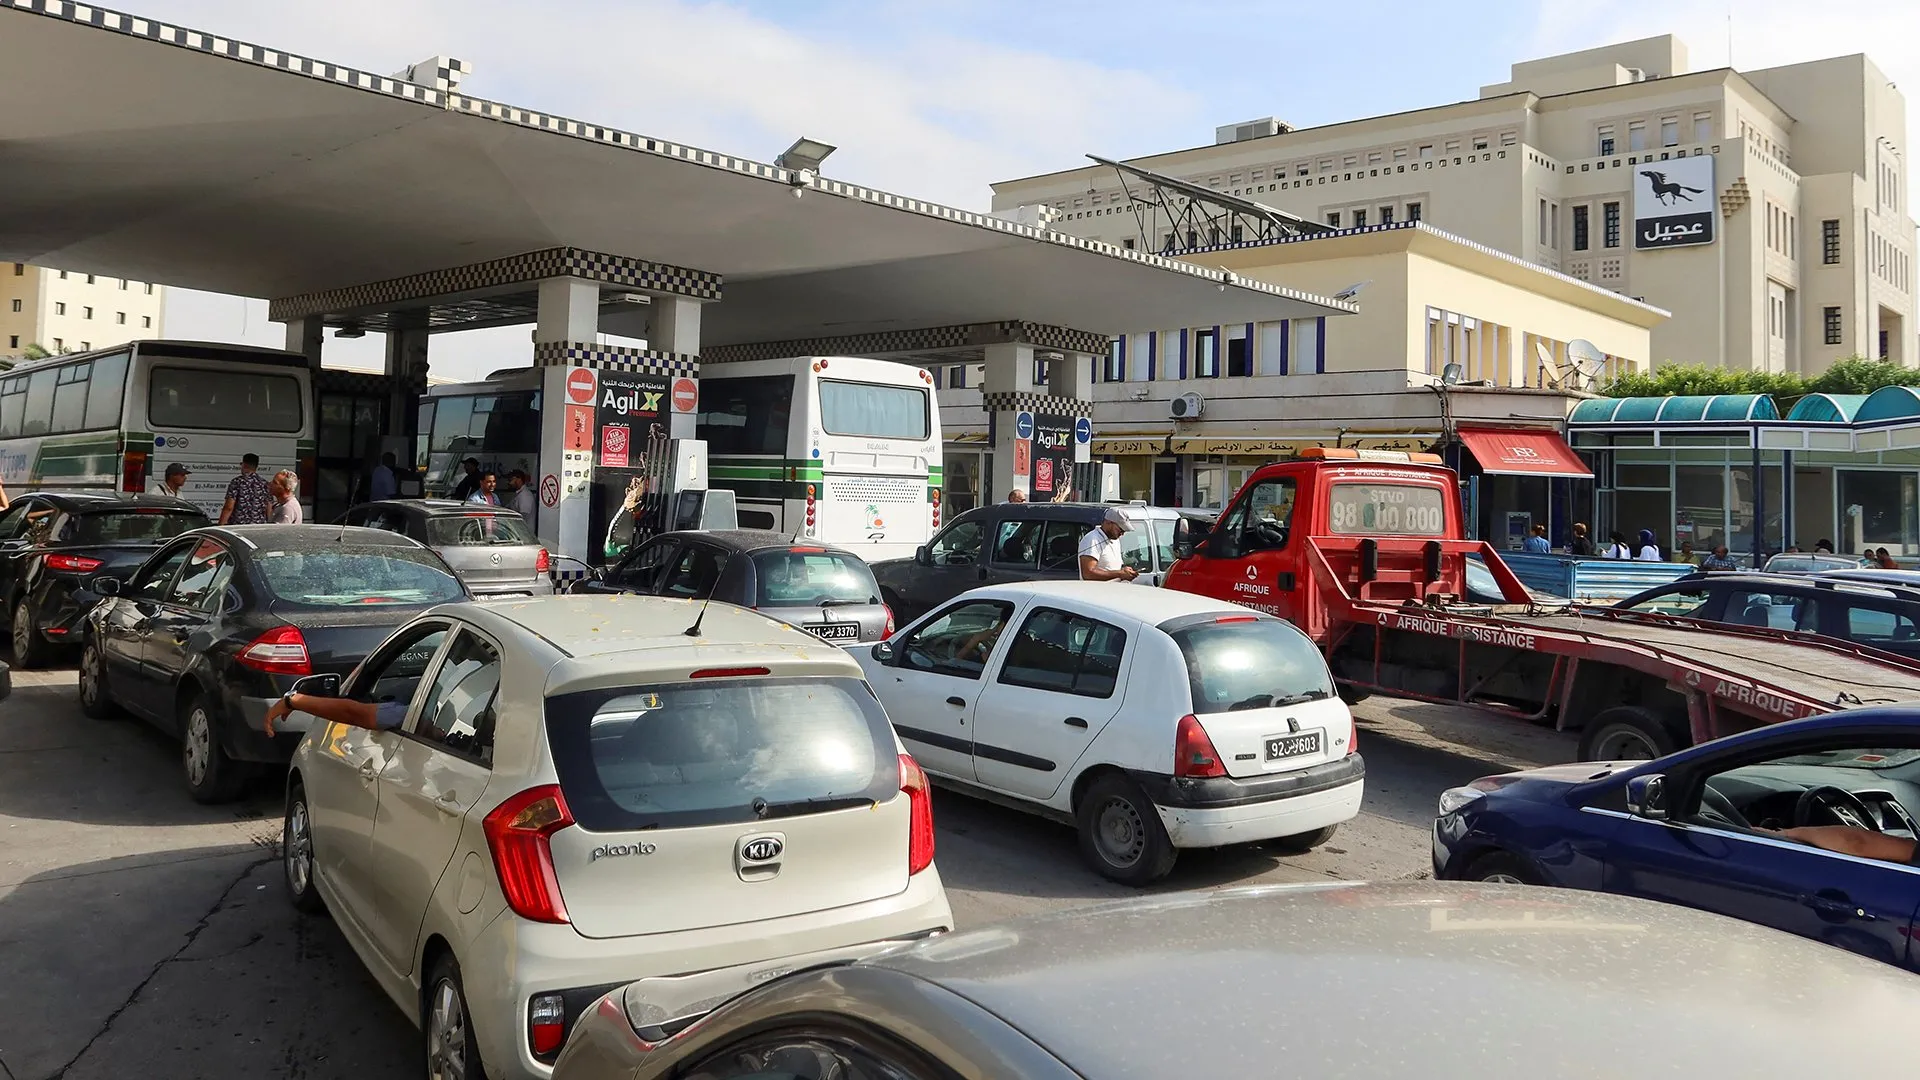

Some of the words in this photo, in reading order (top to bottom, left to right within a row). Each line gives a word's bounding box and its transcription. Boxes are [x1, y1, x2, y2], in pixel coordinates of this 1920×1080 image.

[1643, 222, 1704, 242] عجيل
[1113, 442, 1142, 453] الادارة
[1268, 442, 1294, 451] محطة
[1354, 467, 1386, 476] AFRIQUE
[1388, 469, 1432, 480] ASSISTANCE
[1332, 501, 1358, 528] 98
[1405, 506, 1440, 531] 800
[1233, 582, 1270, 595] AFRIQUE
[836, 626, 856, 637] 3370
[1396, 616, 1448, 636] AFRIQUE
[1714, 680, 1797, 717] AFRIQUE
[1271, 741, 1285, 757] 92
[1299, 736, 1316, 753] 603
[592, 840, 657, 862] picanto
[749, 842, 777, 859] KIA
